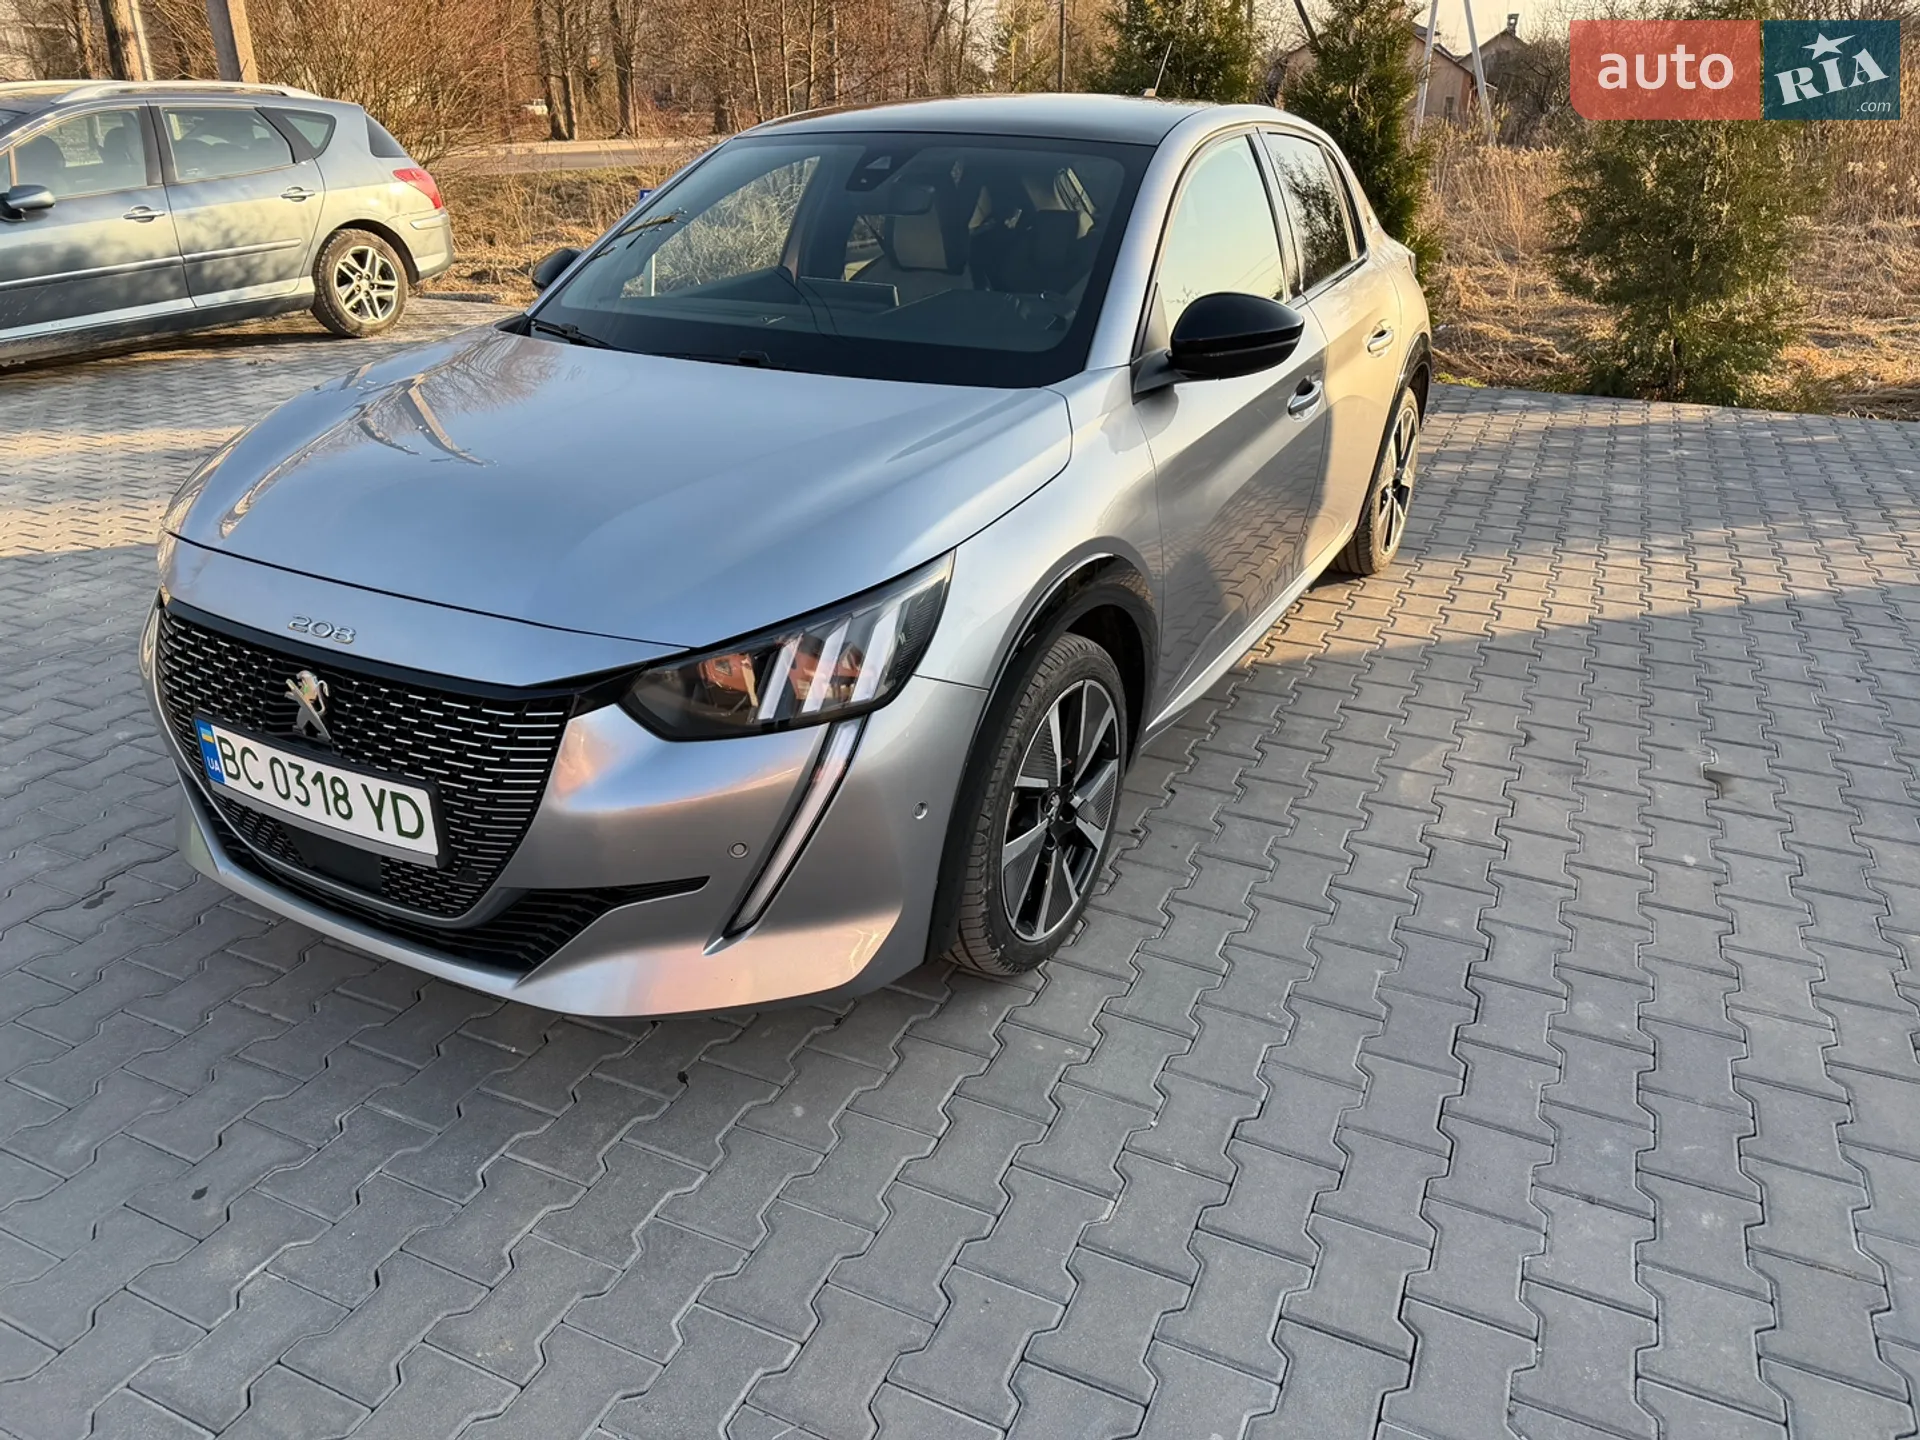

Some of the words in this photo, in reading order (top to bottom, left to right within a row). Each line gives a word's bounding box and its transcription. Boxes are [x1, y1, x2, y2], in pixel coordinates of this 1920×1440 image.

[287, 613, 357, 645] 208
[206, 755, 221, 773] UA
[216, 735, 264, 791] BC
[269, 756, 353, 821] 0318
[361, 783, 424, 840] YD
